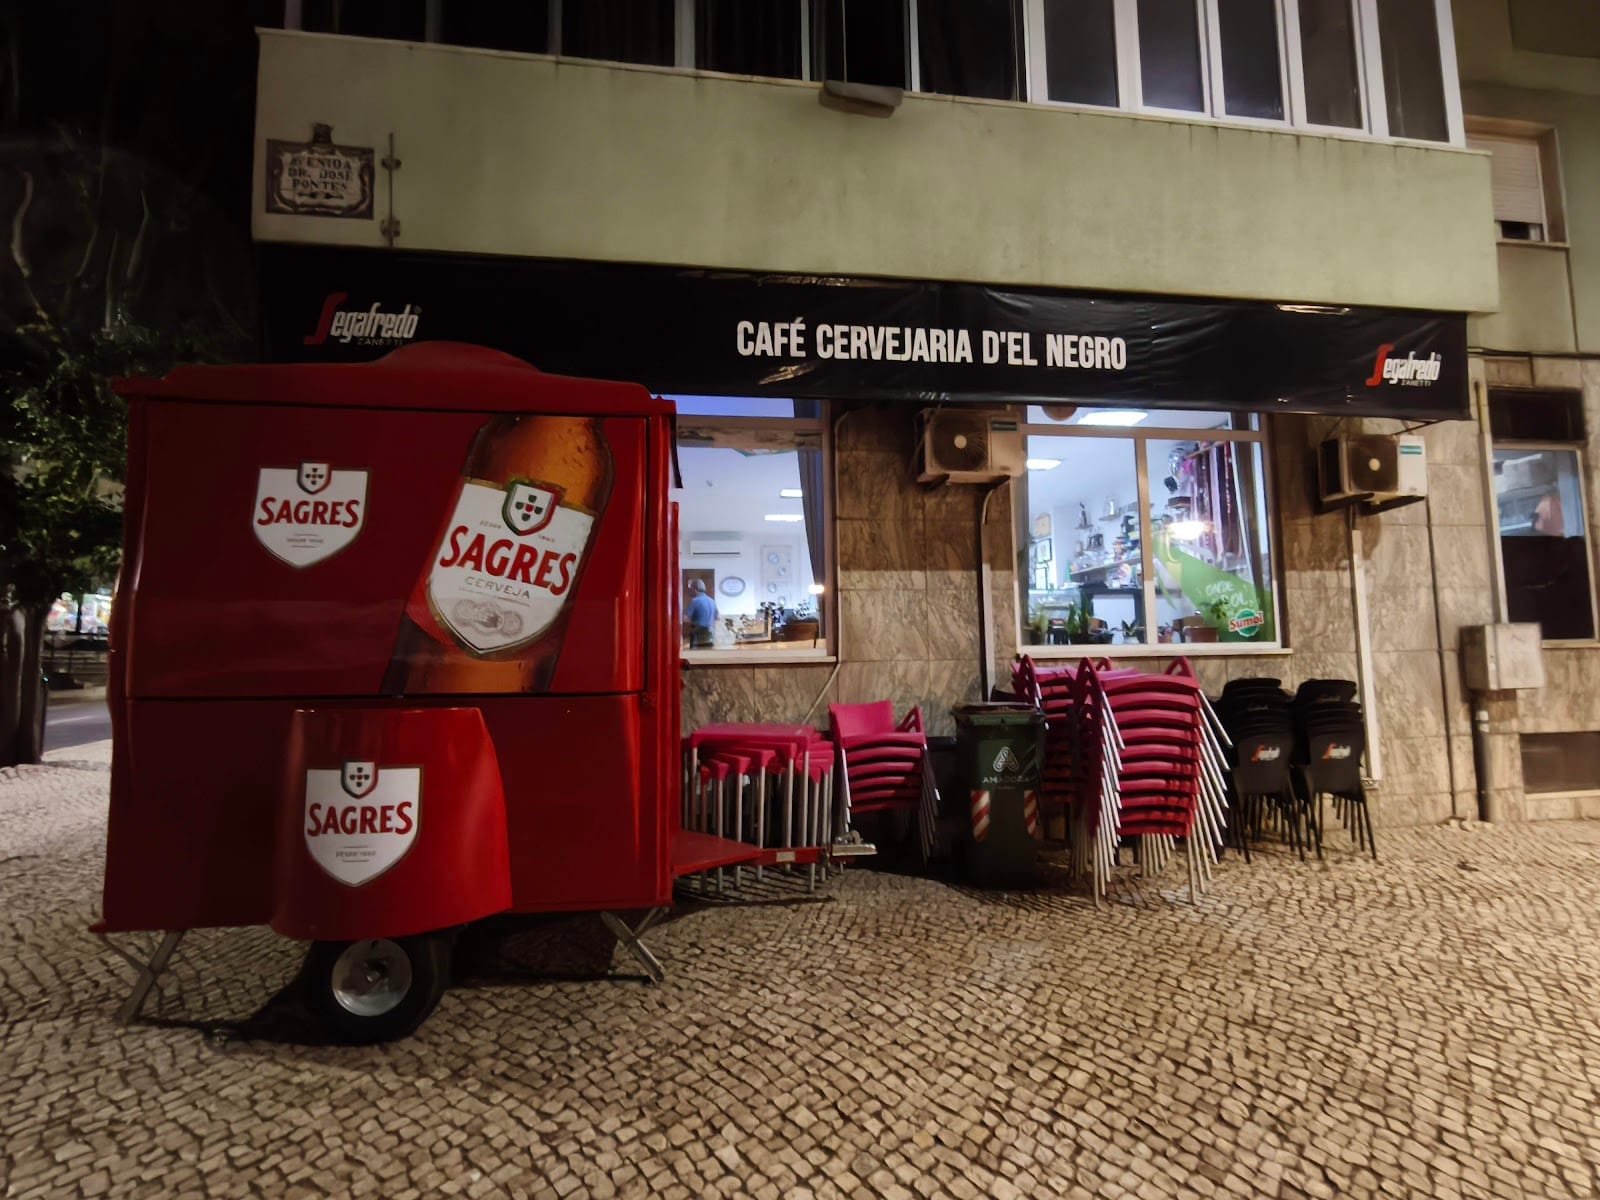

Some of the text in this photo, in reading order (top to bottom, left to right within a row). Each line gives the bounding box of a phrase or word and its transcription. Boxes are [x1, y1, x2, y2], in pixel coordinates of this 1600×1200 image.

[304, 291, 419, 344] Segafredo
[736, 316, 1127, 370] CAFÉ CERVEJARIA D'EL NEGRO
[1365, 343, 1441, 387] Segafredo
[257, 497, 360, 528] SAGRES
[439, 525, 577, 596] SAGRES
[464, 576, 531, 600] CERVEJA
[307, 801, 413, 837] SAGRES
